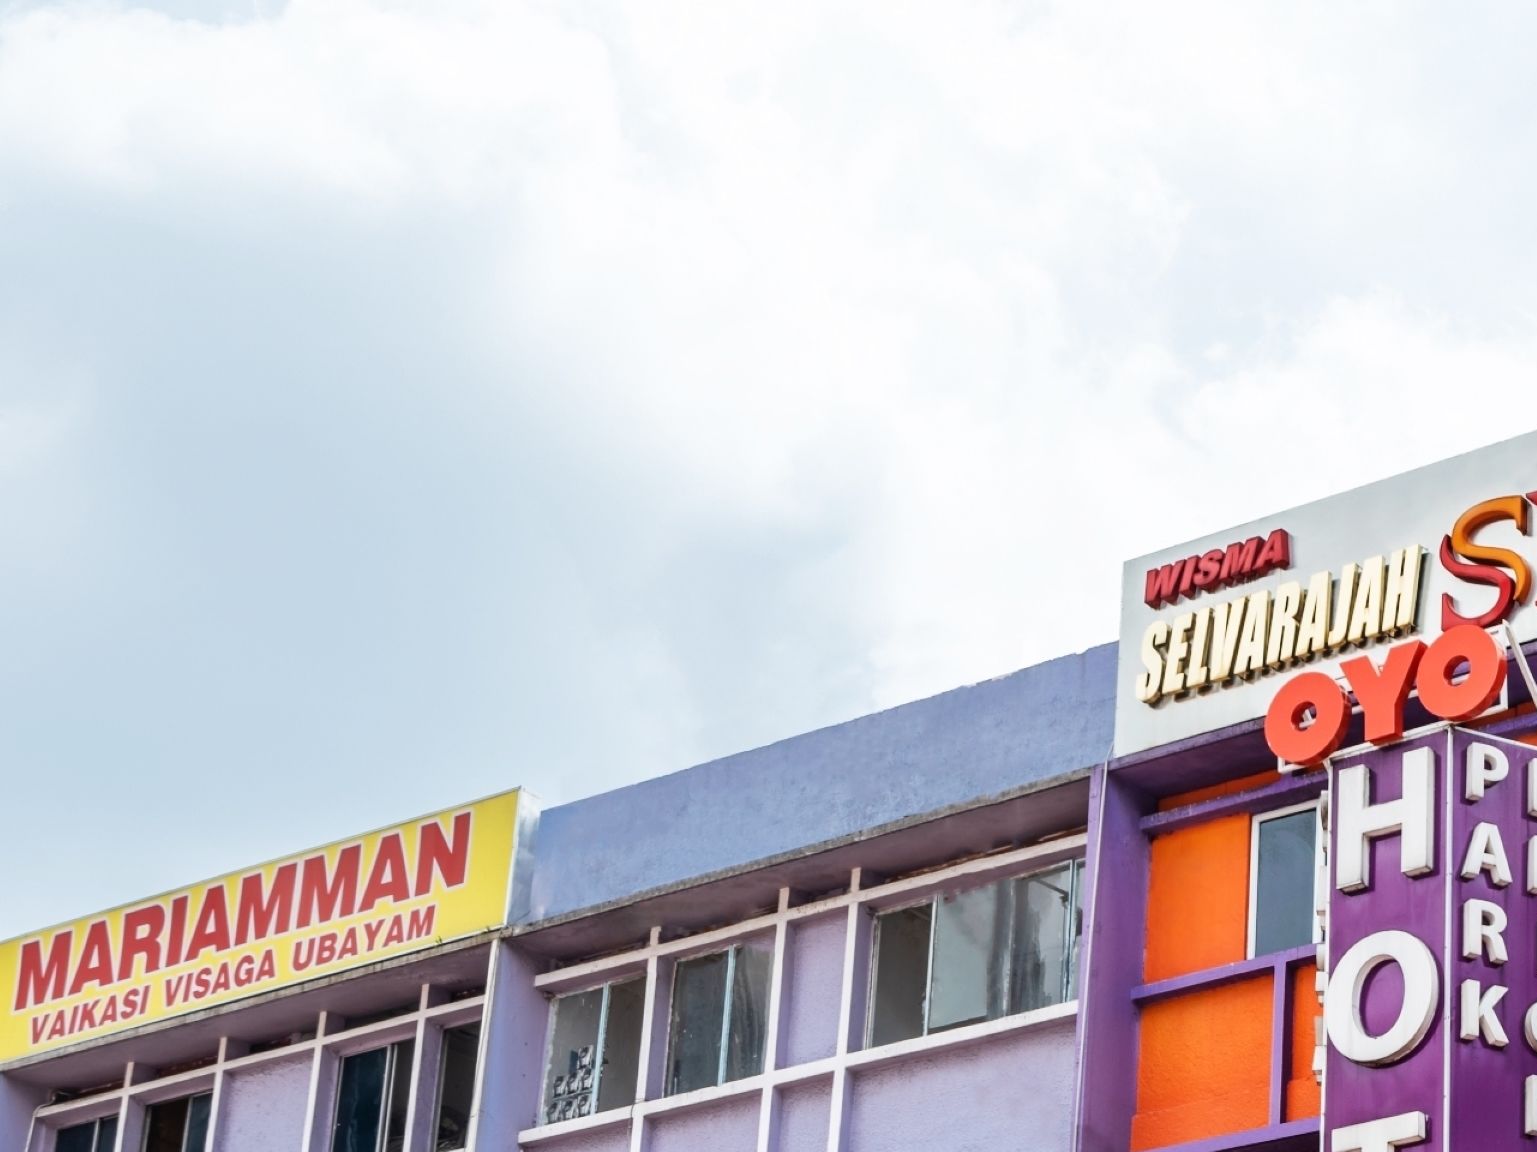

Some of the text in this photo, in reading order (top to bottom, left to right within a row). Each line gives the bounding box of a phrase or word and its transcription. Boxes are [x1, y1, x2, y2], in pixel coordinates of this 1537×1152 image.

[1136, 544, 1428, 705] SELVARAJAH
[1144, 528, 1291, 609] WISMA
[1264, 624, 1508, 766] OYO
[14, 811, 472, 1012] MARIAMMAN
[1460, 741, 1513, 1047] PARK
[31, 905, 437, 1046] VAIKASI VISAGA UBAYAM
